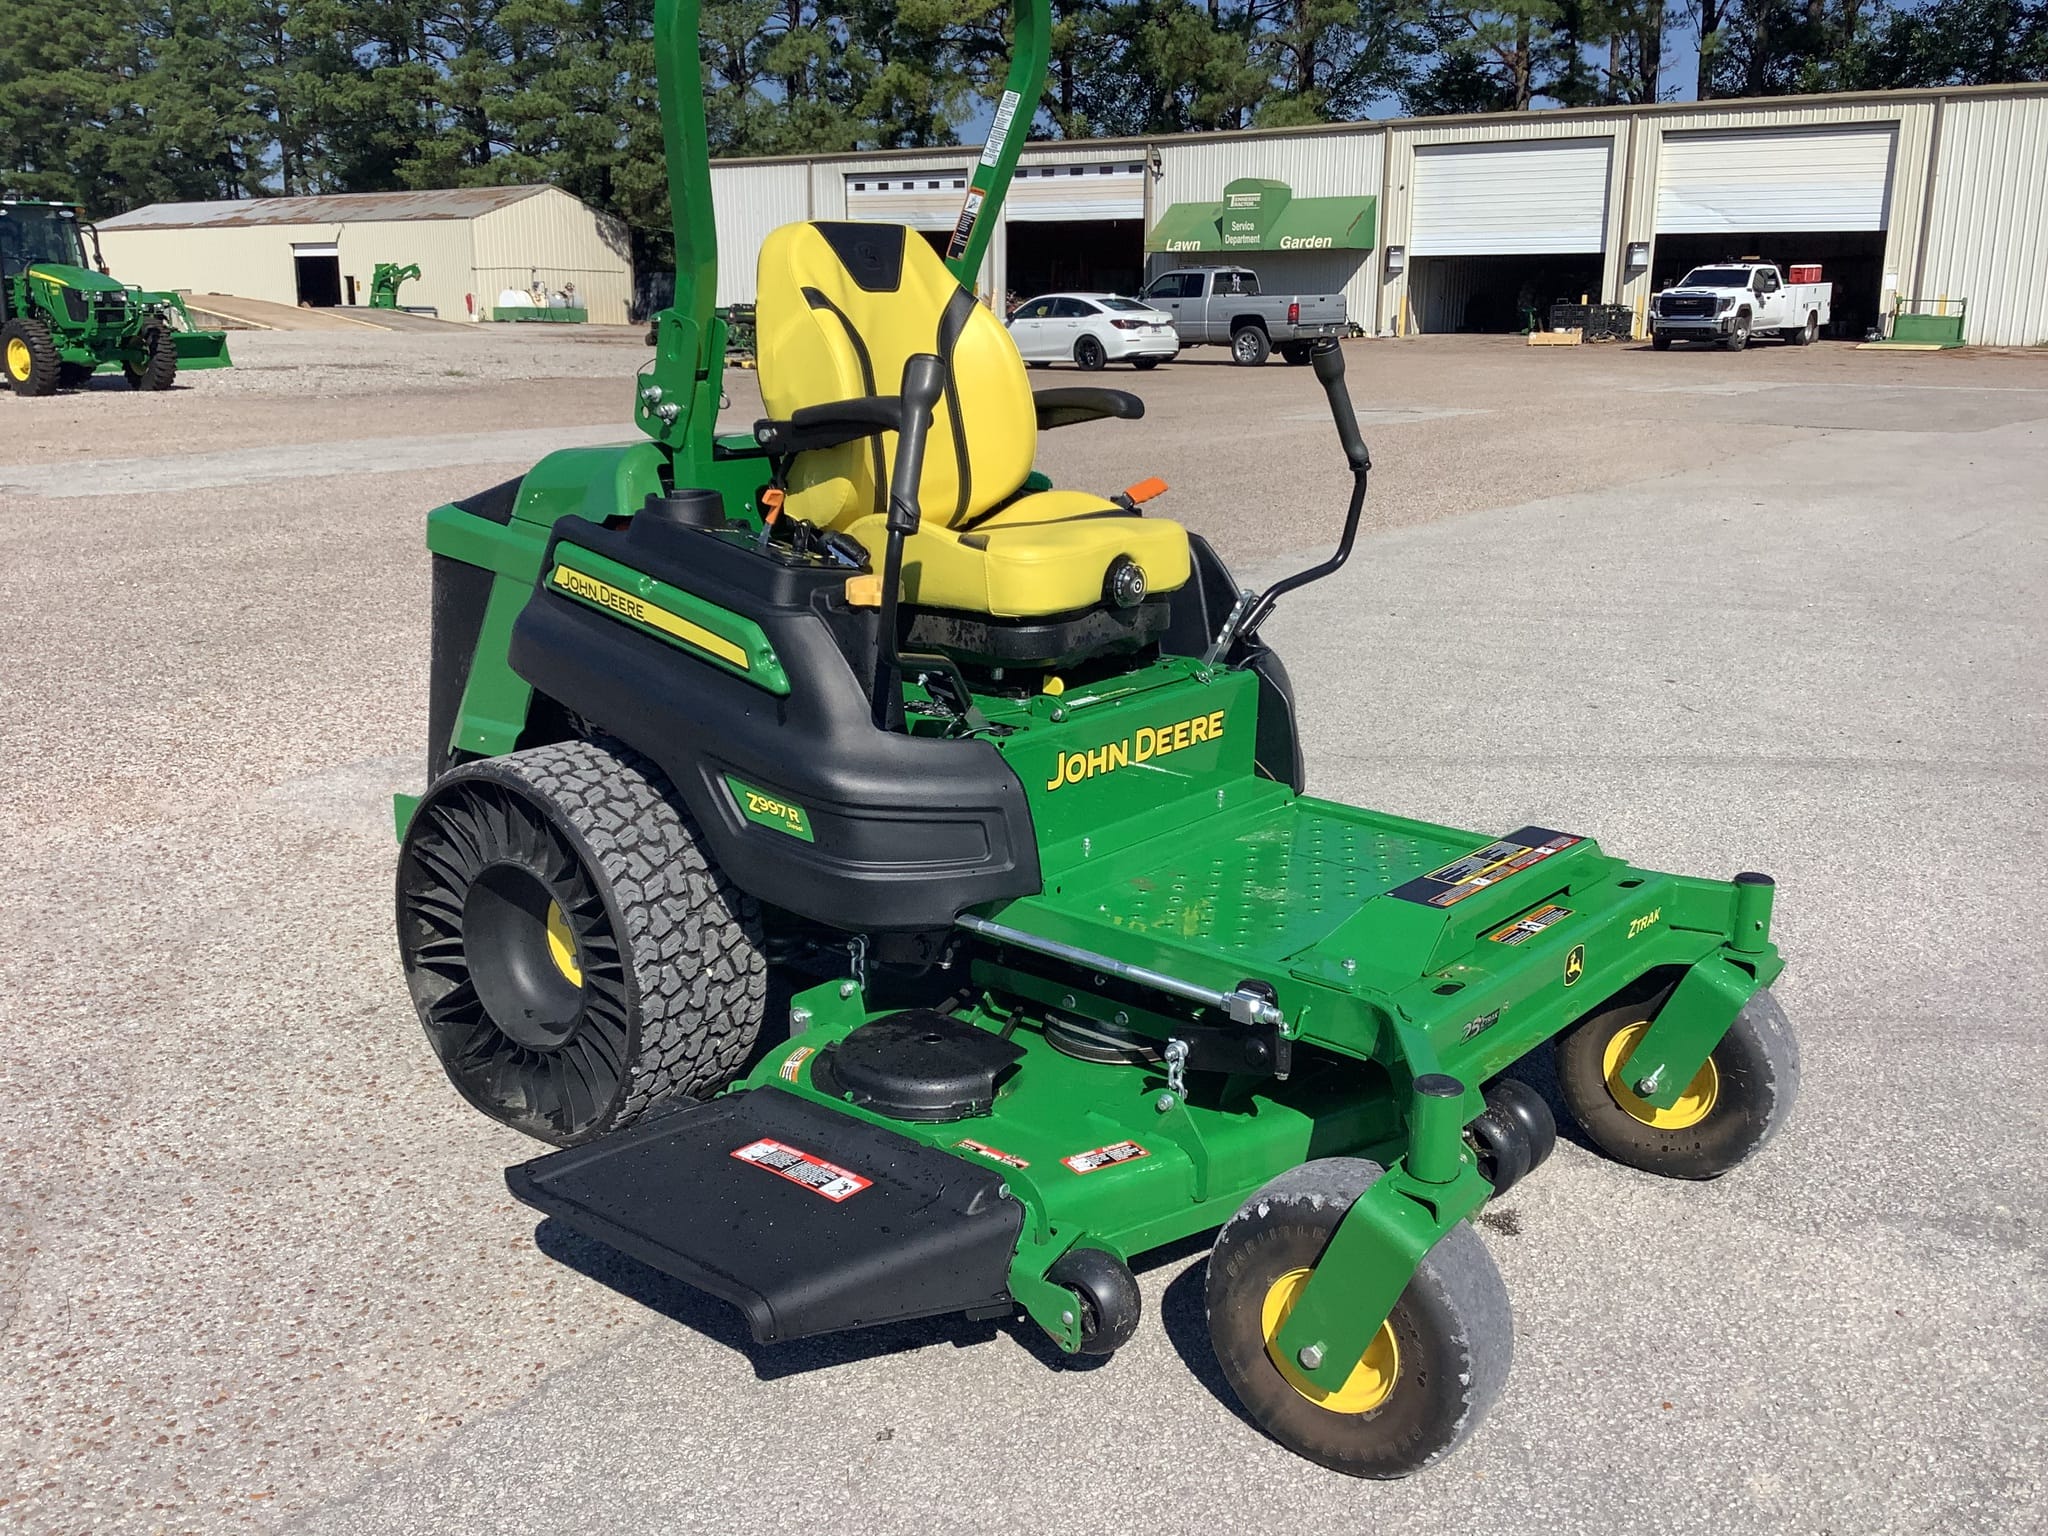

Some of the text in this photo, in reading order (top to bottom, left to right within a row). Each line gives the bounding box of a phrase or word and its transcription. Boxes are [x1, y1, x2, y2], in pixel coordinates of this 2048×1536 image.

[1231, 220, 1255, 231] Service
[1166, 238, 1201, 251] Lawn
[1224, 233, 1261, 246] Department
[1280, 236, 1333, 249] Garden
[563, 572, 644, 619] JOHN DEERE
[1047, 709, 1225, 792] JOHN DEERE
[1627, 906, 1662, 940] ZTRAK
